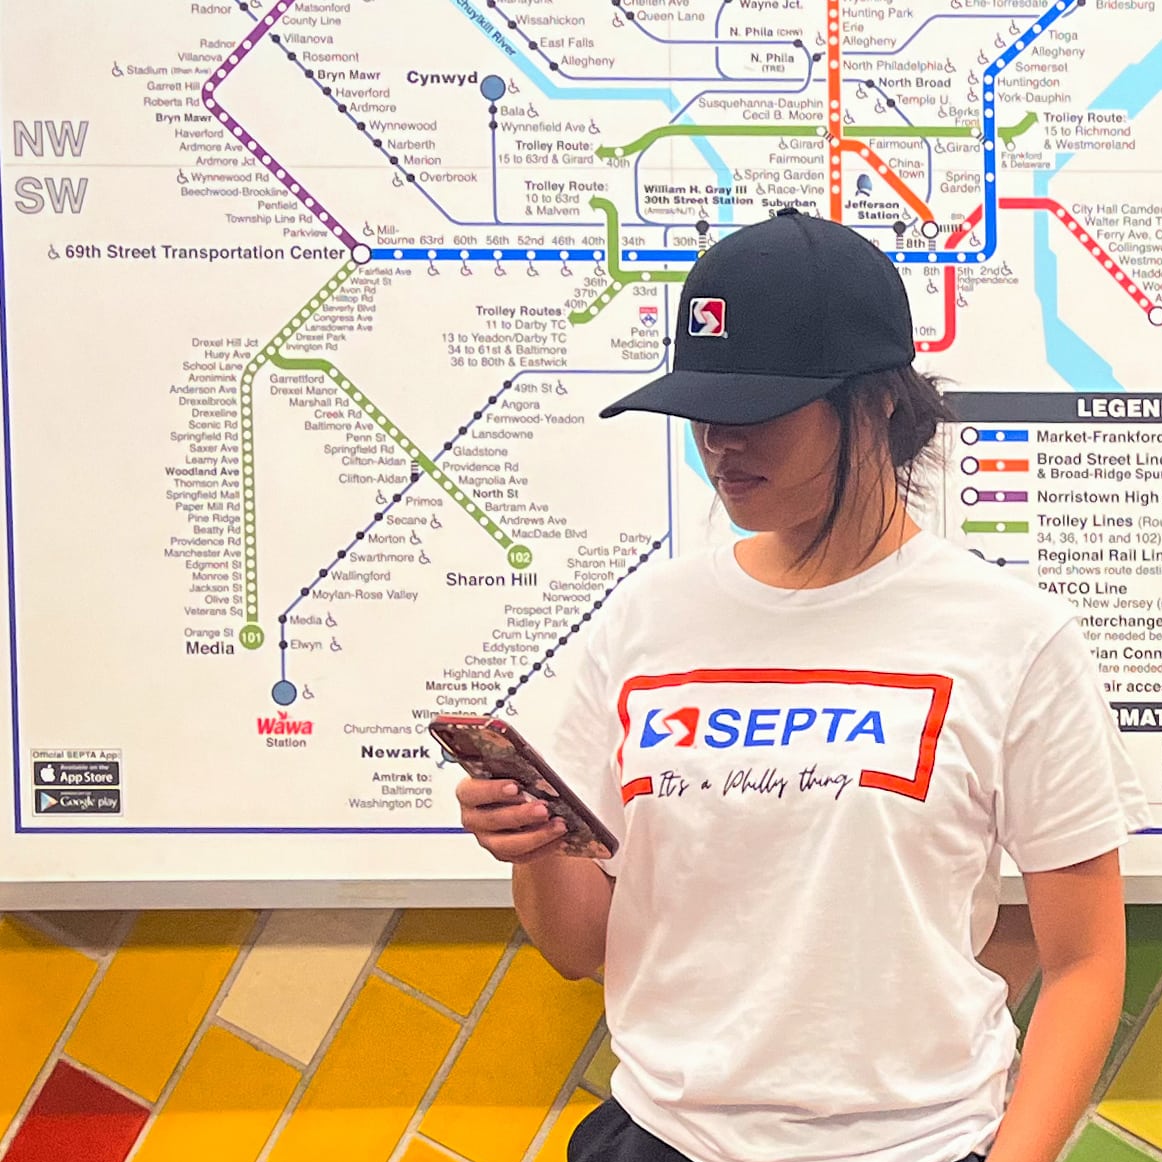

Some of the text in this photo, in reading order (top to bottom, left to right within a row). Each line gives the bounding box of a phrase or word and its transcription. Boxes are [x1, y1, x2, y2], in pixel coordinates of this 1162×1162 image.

[318, 70, 380, 82] Bryn Mawr
[407, 71, 477, 86] Cynwyd
[156, 113, 212, 124] Bryn Mawr
[1044, 112, 1128, 127] Trolley Route:
[369, 120, 437, 133] Wynnewood
[13, 120, 89, 157] NW
[516, 140, 594, 153] Trolley Route:
[420, 171, 477, 182] Overbrook
[14, 177, 88, 214] SW
[845, 200, 899, 208] Jefferson
[1072, 204, 1093, 217] City
[1097, 204, 1117, 214] Hall
[858, 211, 899, 219] Station
[66, 245, 345, 262] 69th Street Transportation Center
[476, 306, 566, 318] Trolley Routes:
[1038, 453, 1081, 465] Broad
[1087, 453, 1130, 465] Street
[165, 467, 239, 476] Woodland Ave
[1037, 468, 1045, 479] &
[1051, 468, 1131, 481] Broad-Ridge
[473, 489, 518, 498] North St
[1038, 491, 1119, 503] Norristown
[1125, 491, 1158, 506] High
[1038, 514, 1087, 530] Trolley
[1093, 515, 1133, 527] Lines
[1037, 532, 1161, 545] 34, 36, 101 and 102)
[511, 552, 532, 566] 102
[1038, 549, 1103, 564] Regional
[1109, 549, 1136, 561] Rail
[447, 573, 536, 586] Sharon Hill
[1096, 582, 1127, 594] Line
[1083, 597, 1109, 608] New
[1113, 598, 1153, 611] Jersey
[242, 632, 261, 643] 101
[187, 641, 234, 654] Media
[257, 717, 313, 735] Wawa
[704, 708, 886, 748] SEPTA
[266, 737, 306, 747] Station
[362, 746, 429, 758] Newark
[60, 772, 113, 784] App Store
[372, 771, 433, 783] Amtrak to:
[723, 768, 788, 798] Philly
[799, 764, 852, 800] thing
